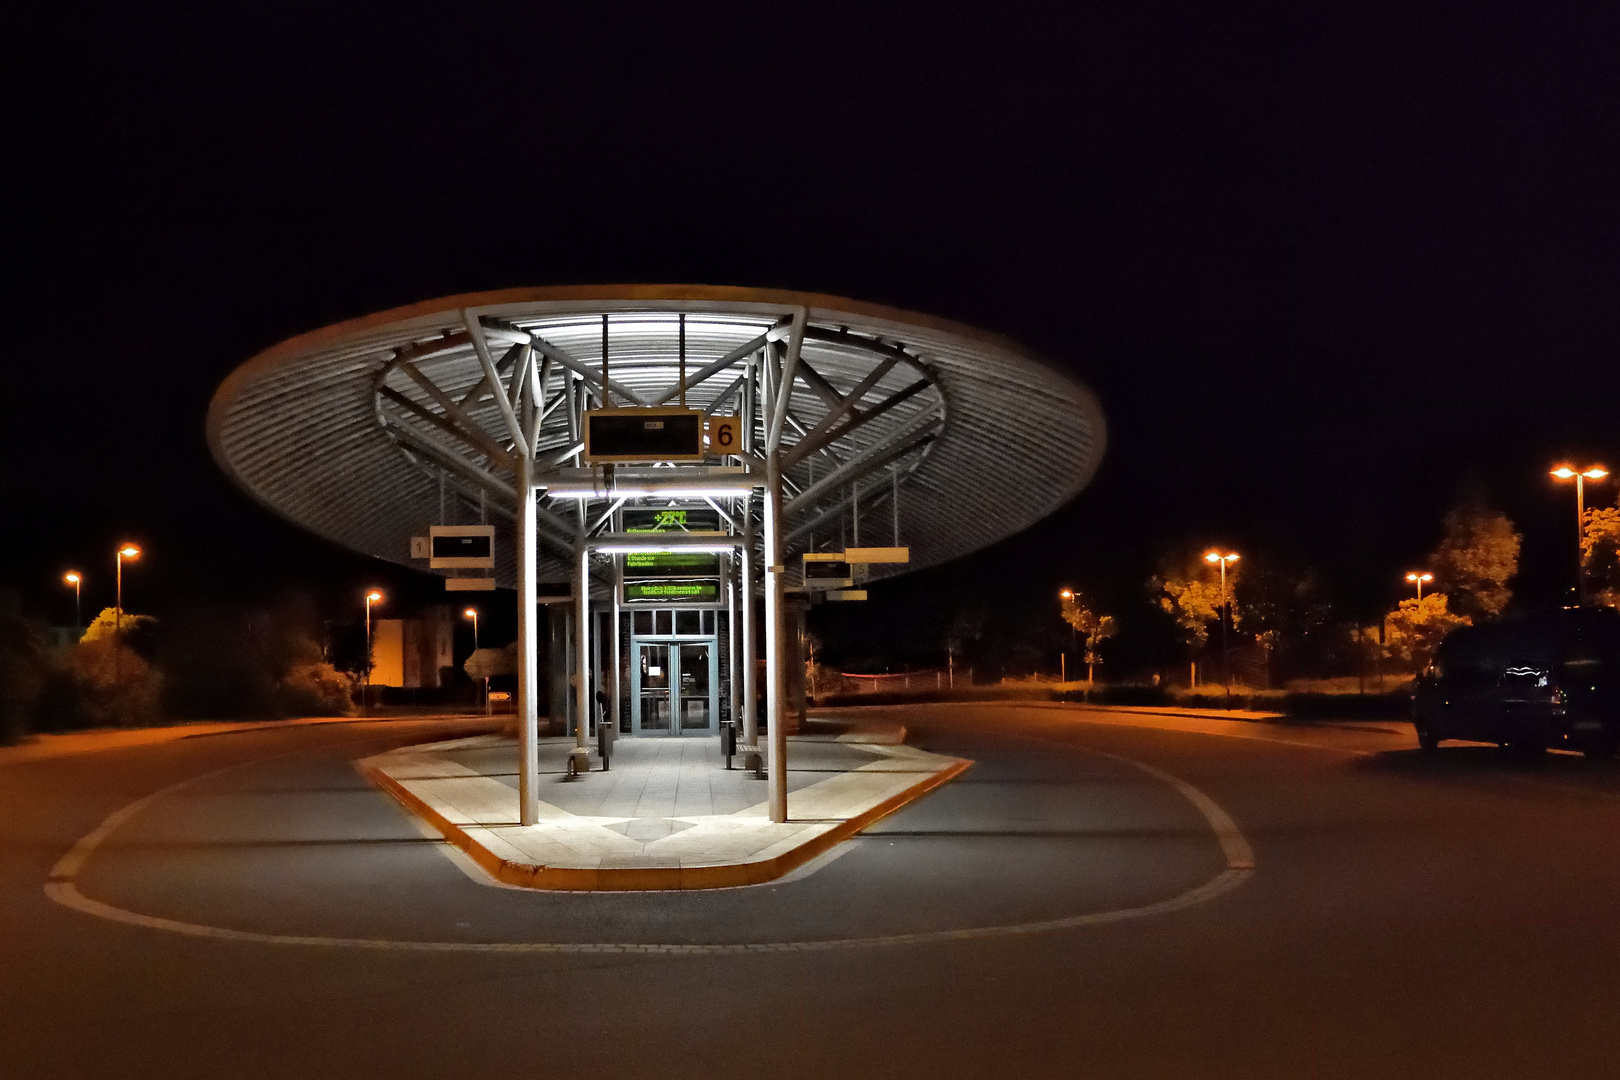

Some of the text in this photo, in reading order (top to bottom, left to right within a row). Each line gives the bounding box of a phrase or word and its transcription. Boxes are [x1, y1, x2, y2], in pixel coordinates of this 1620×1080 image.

[717, 424, 733, 446] 6
[416, 542, 422, 552] 1
[858, 565, 866, 574] 5
